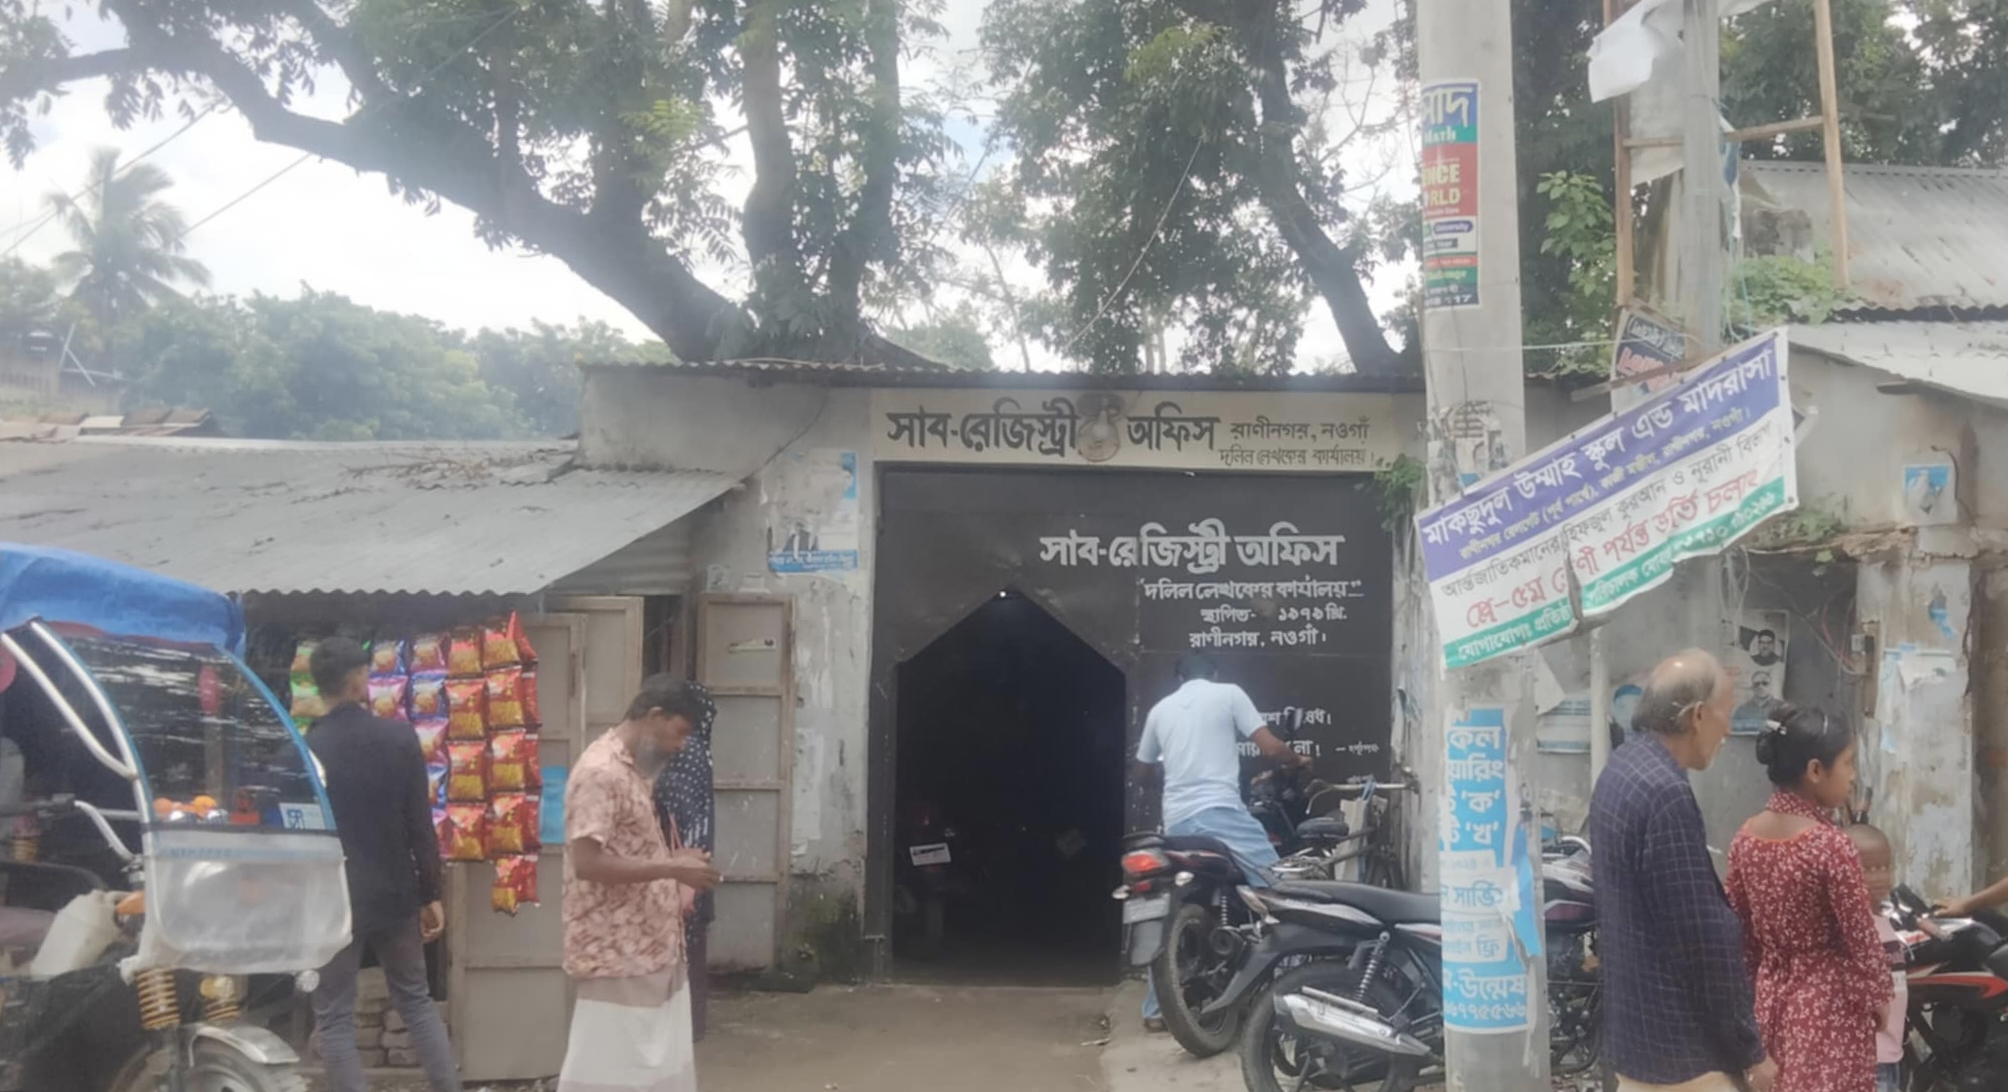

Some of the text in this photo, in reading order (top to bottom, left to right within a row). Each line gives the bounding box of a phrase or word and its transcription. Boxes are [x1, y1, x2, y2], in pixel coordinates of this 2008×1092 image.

[1126, 401, 1221, 451] অফিস
[1321, 415, 1370, 440] নওগাঁ
[1422, 486, 1512, 545] মাকছুদুল
[1513, 451, 1583, 498] উম্মাহ
[1581, 426, 1626, 471] স্কুল
[1631, 401, 1674, 439] এন্ড
[1677, 349, 1773, 414] মাদরাসা
[1219, 444, 1255, 467] দলিল
[1672, 470, 1685, 485] ও
[1233, 521, 1346, 566] অফিস
[1603, 518, 1650, 561] পর্যন্ত
[1652, 487, 1700, 534] ভর্তি
[1189, 626, 1266, 648] রাণীনগর,
